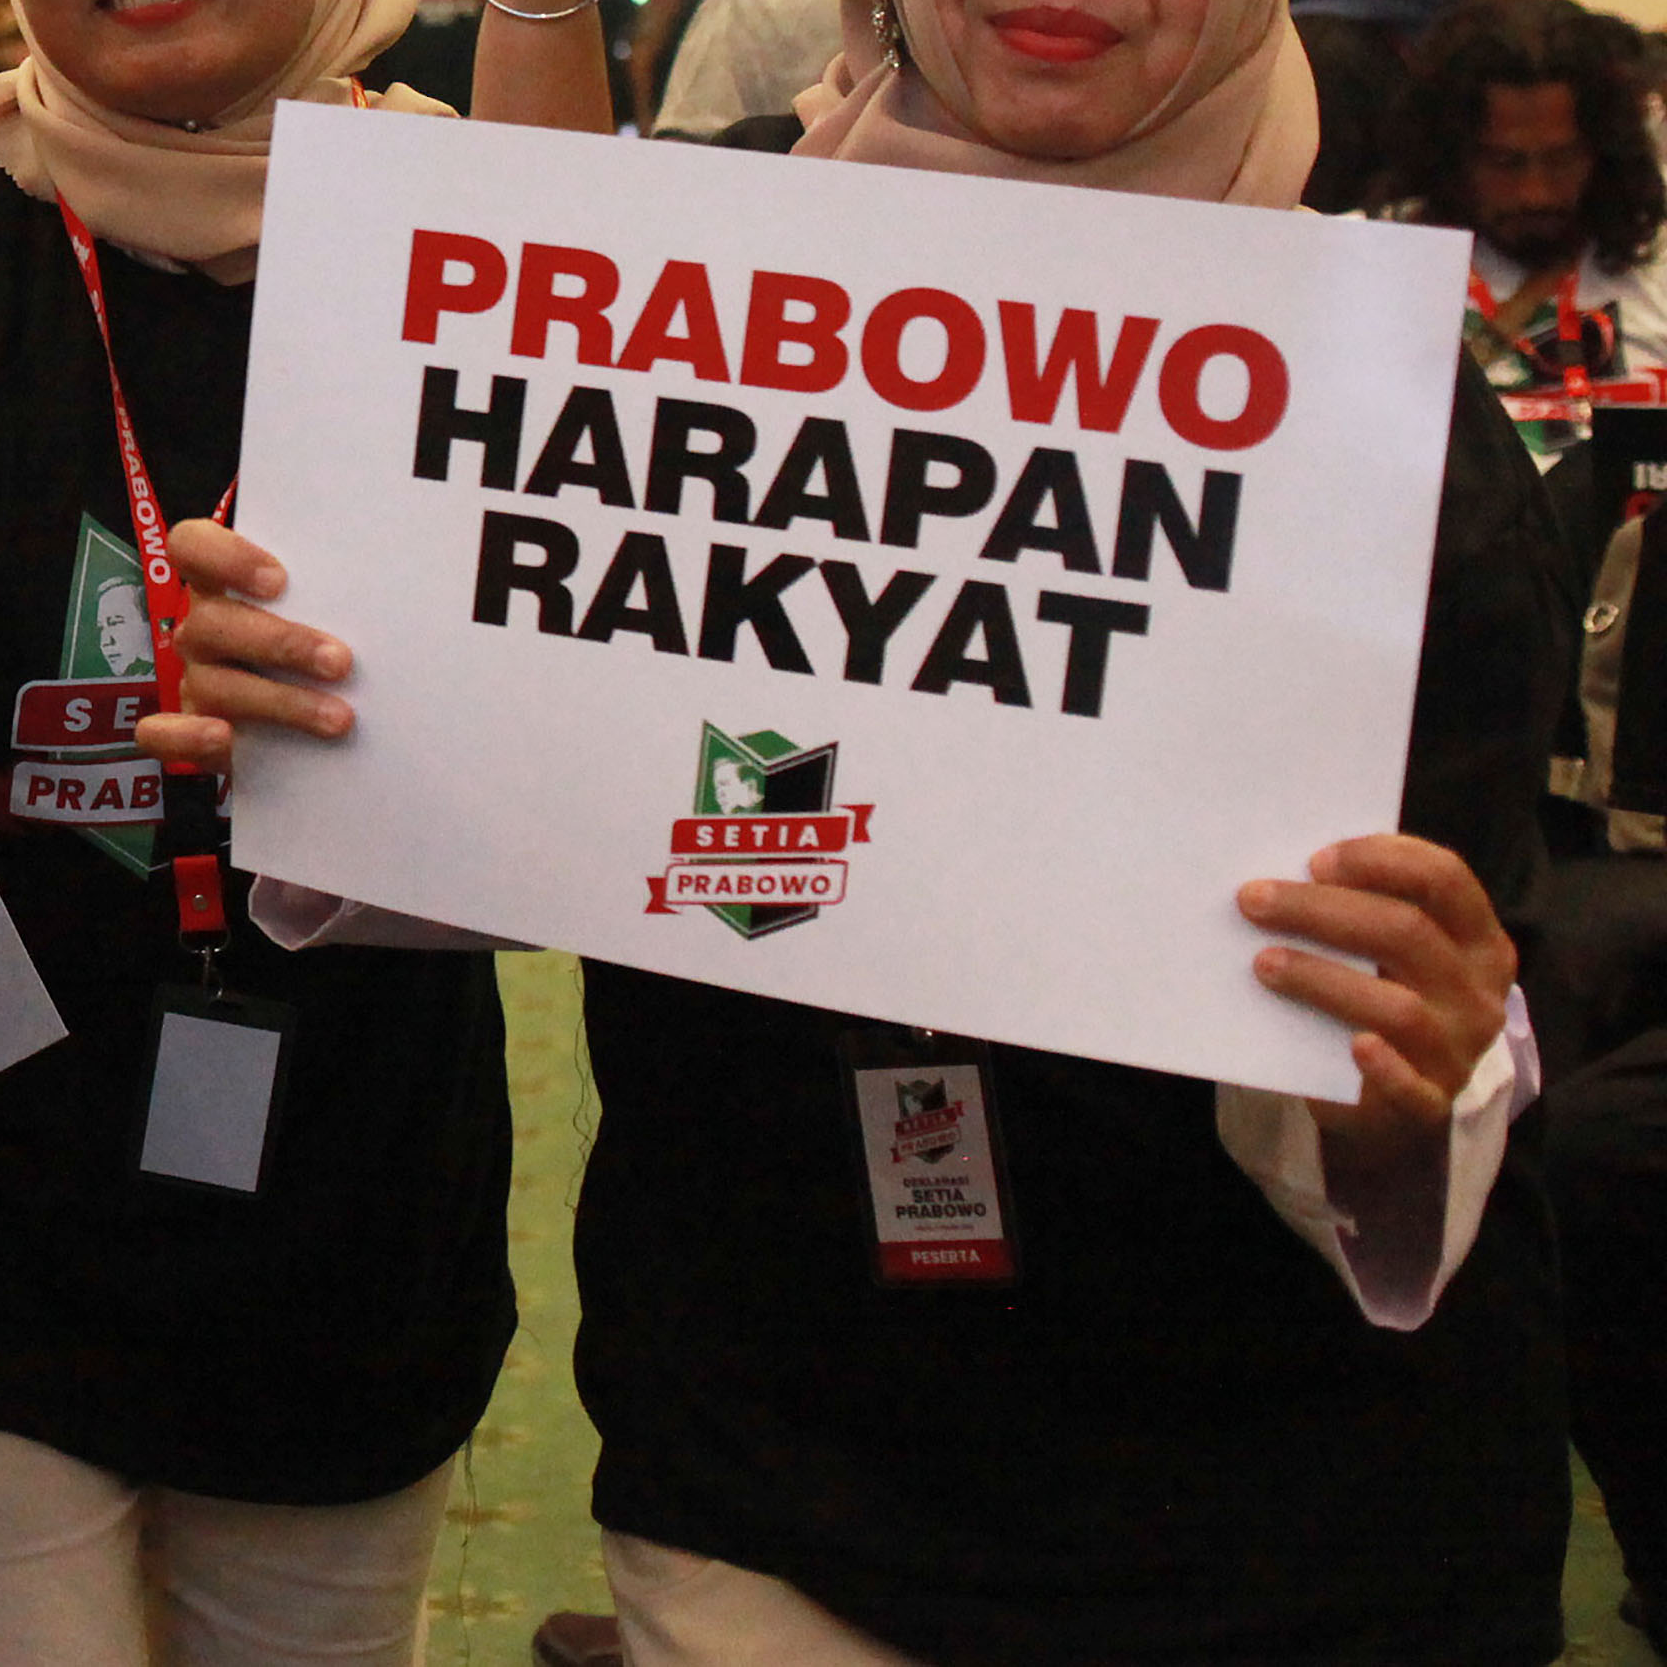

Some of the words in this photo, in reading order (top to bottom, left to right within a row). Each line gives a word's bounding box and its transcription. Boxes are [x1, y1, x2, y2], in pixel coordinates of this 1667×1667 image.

[401, 228, 1291, 452] PRABOWO
[411, 365, 1245, 594] HARAPAN
[471, 509, 1151, 720] RAKYAT
[27, 774, 232, 812] PRAB
[696, 825, 820, 847] SETIA
[677, 874, 832, 896] PRABOWO
[912, 1189, 965, 1203] SETIA
[895, 1203, 987, 1219] PRABOWO
[910, 1248, 981, 1265] PESERTA
